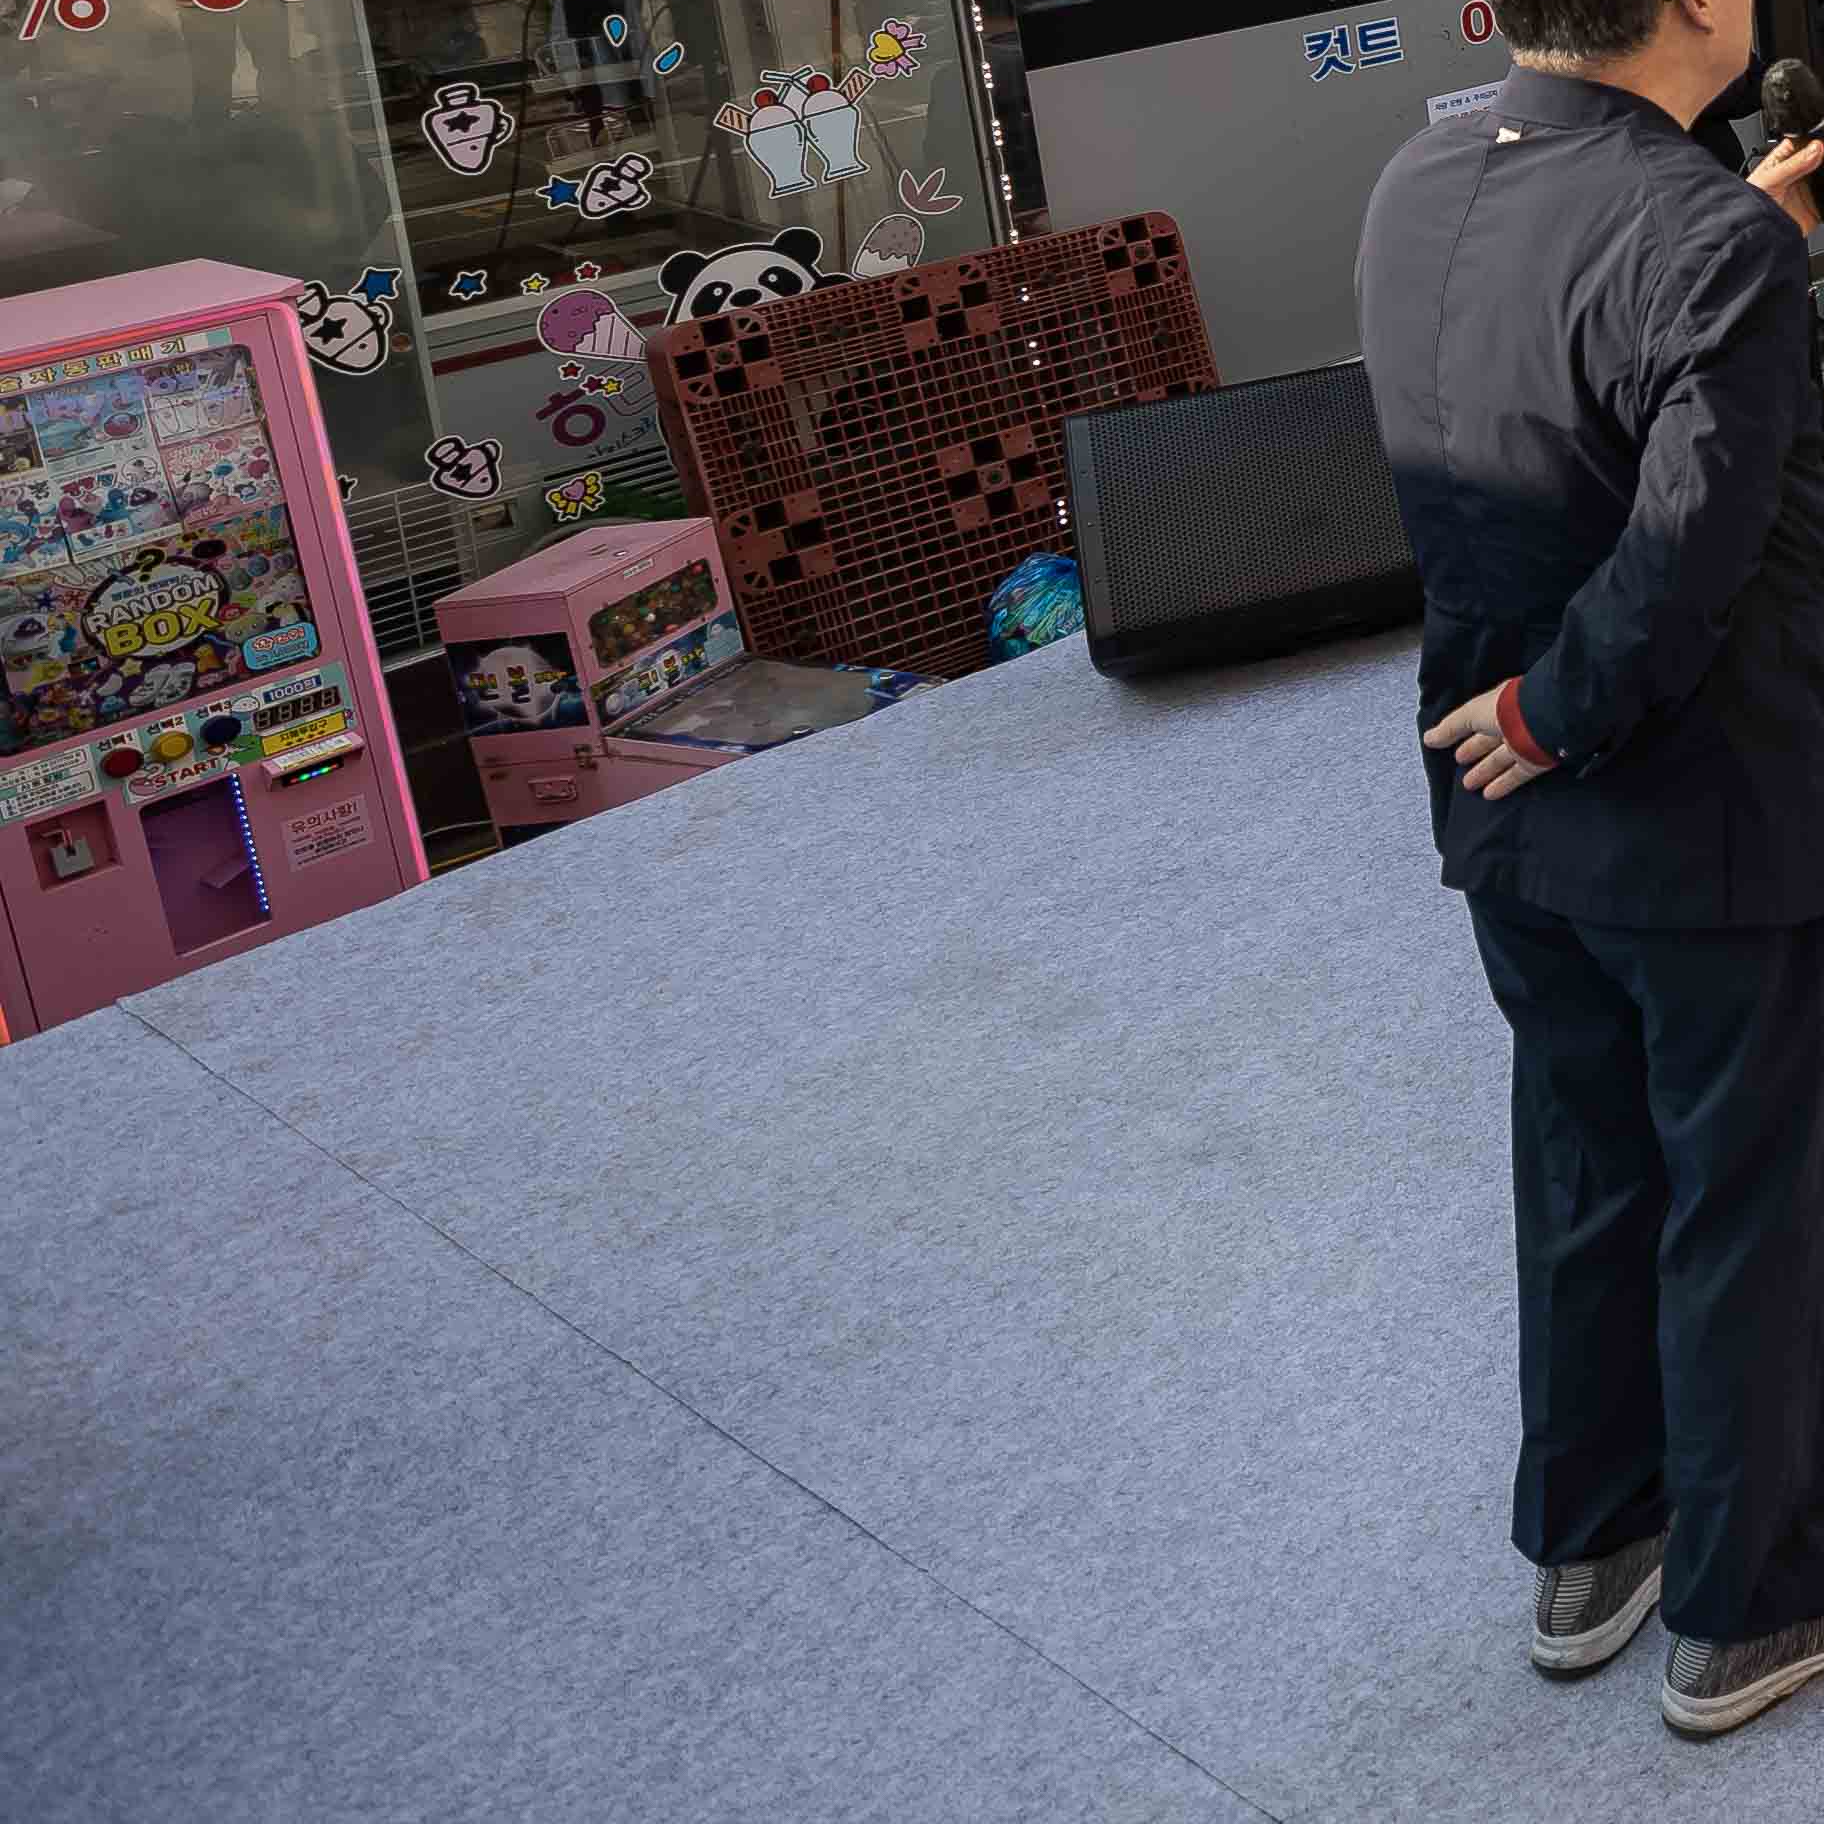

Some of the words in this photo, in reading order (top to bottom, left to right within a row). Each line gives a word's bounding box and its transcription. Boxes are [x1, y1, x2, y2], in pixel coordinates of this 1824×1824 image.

[1303, 16, 1404, 82] 컷트
[84, 574, 222, 633] RANDOM
[104, 598, 222, 657] BOX
[154, 757, 221, 789] START
